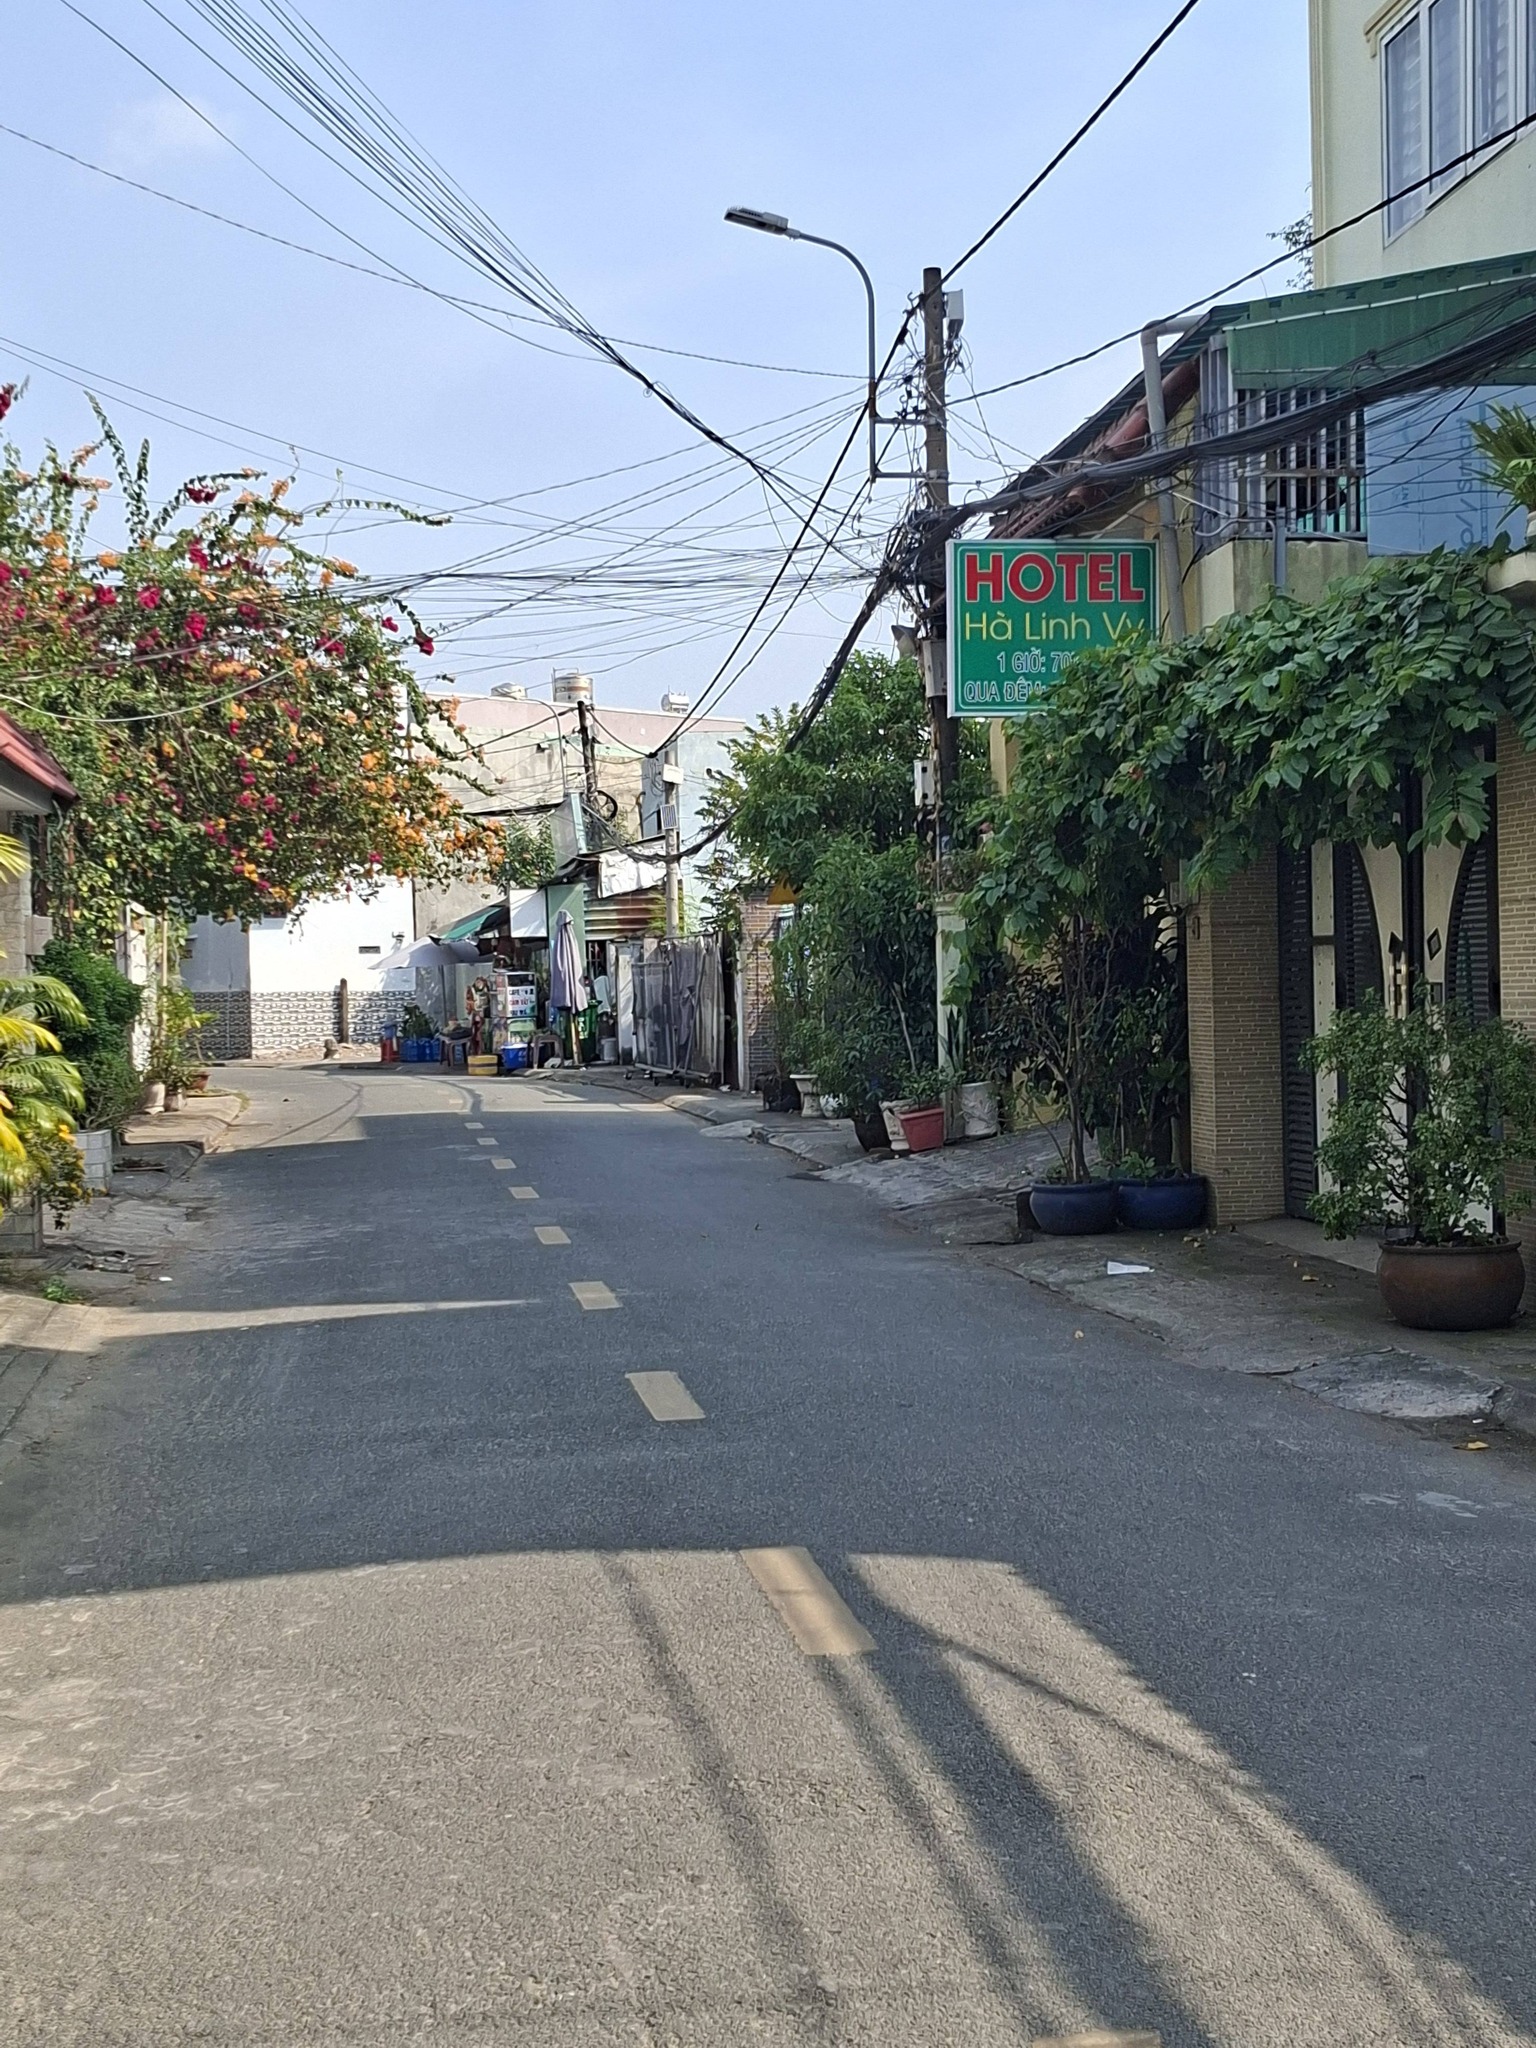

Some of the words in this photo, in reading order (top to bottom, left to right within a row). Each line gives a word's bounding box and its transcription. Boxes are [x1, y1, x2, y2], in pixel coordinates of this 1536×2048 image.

[965, 552, 1146, 604] HOTEL
[965, 611, 1012, 640] Hà
[1025, 611, 1091, 640] Linh
[1102, 611, 1145, 641] Vy
[996, 651, 1006, 673] 1
[1011, 647, 1047, 673] GIỜ:
[1050, 651, 1073, 673] 70
[964, 681, 1000, 702] QUA
